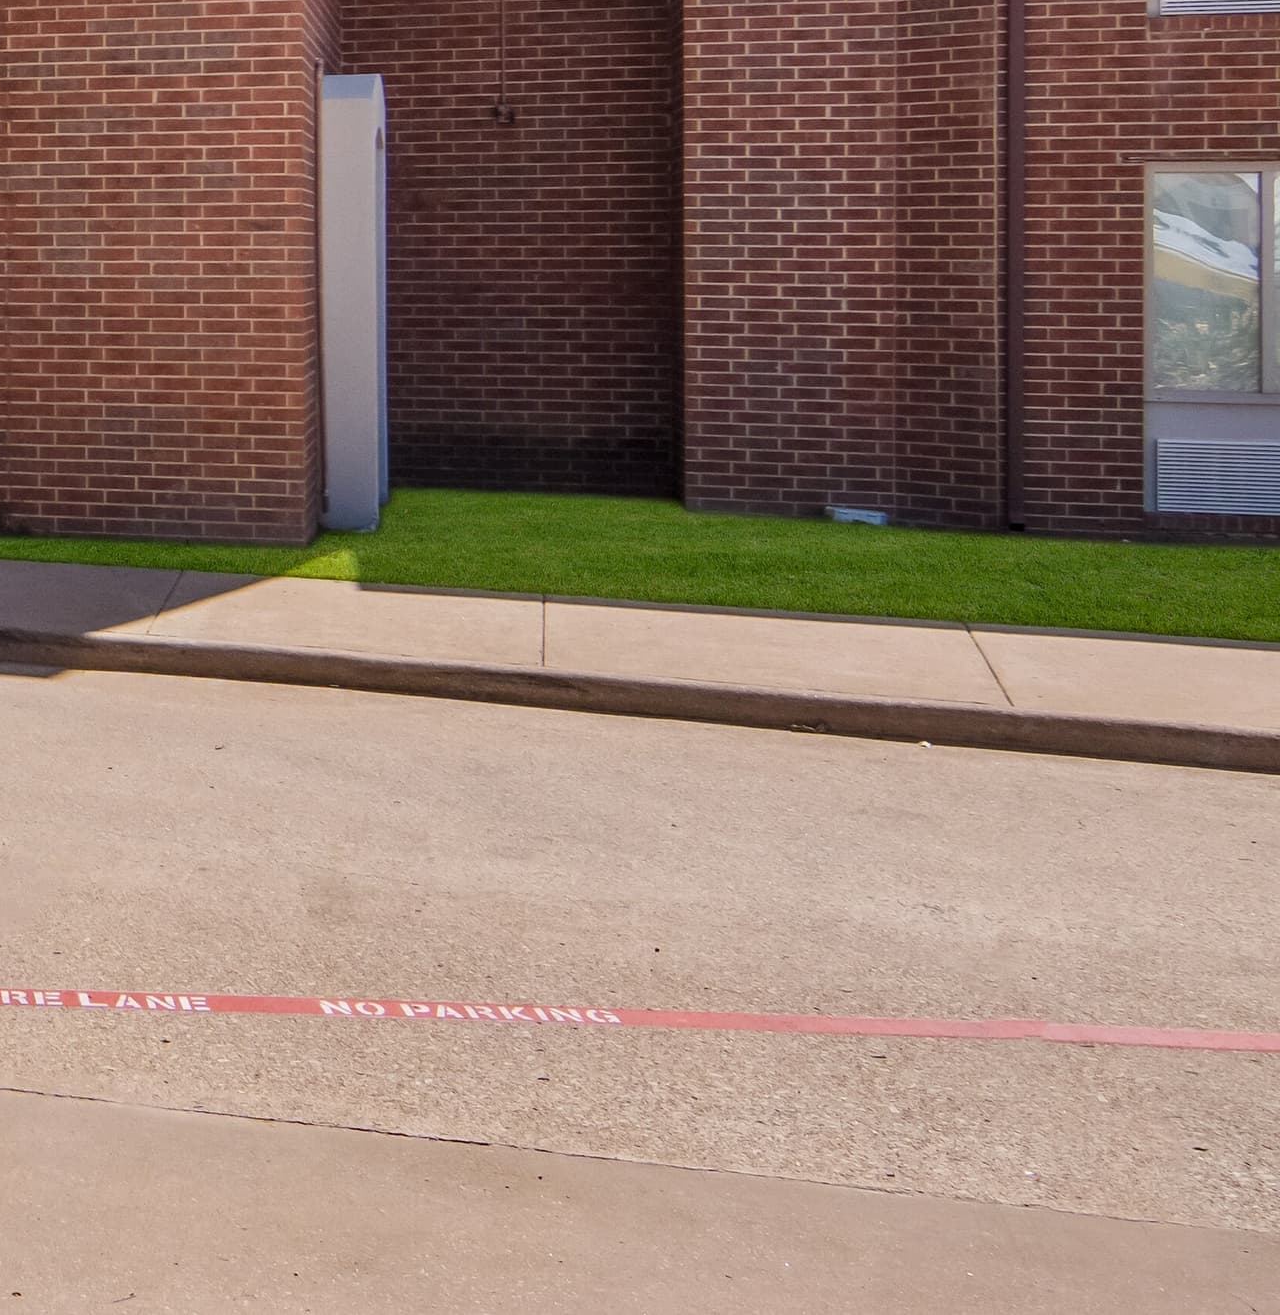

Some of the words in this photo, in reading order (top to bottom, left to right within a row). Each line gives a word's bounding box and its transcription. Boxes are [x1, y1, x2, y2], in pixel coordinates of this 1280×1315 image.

[77, 992, 211, 1012] LANE
[319, 999, 386, 1016] NO
[400, 1001, 622, 1024] PARKING
